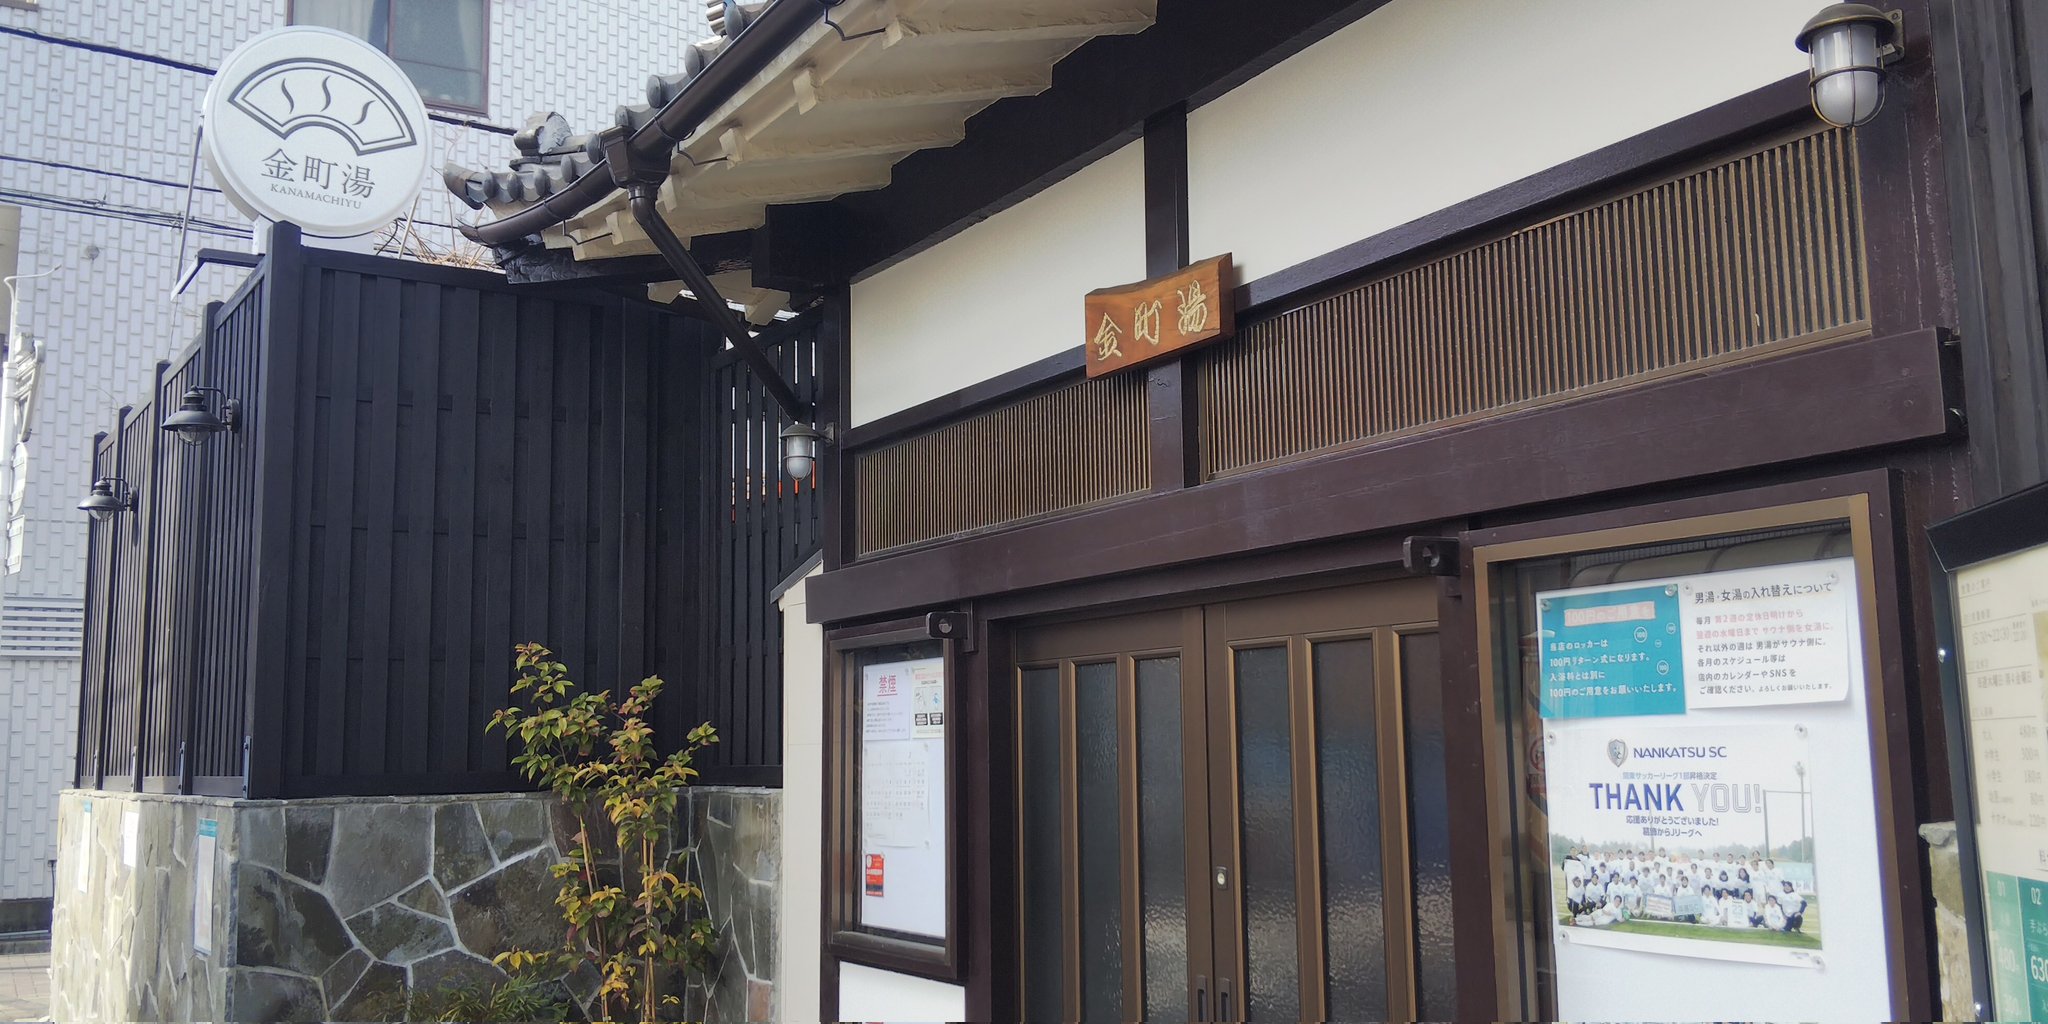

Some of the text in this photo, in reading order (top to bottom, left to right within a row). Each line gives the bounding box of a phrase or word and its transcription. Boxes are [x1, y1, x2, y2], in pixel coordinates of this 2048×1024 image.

[260, 148, 376, 199] 金町湯
[270, 183, 362, 210] KANAMACHIYU
[1094, 280, 1207, 361] 金町湯
[1694, 582, 1833, 605] 男湯・女湯の入れ替えについて
[878, 674, 897, 694] 禁煙
[1633, 746, 1728, 759] NANKATSU SC
[1589, 783, 1762, 813] THANK YOU!
[2030, 887, 2042, 905] 02
